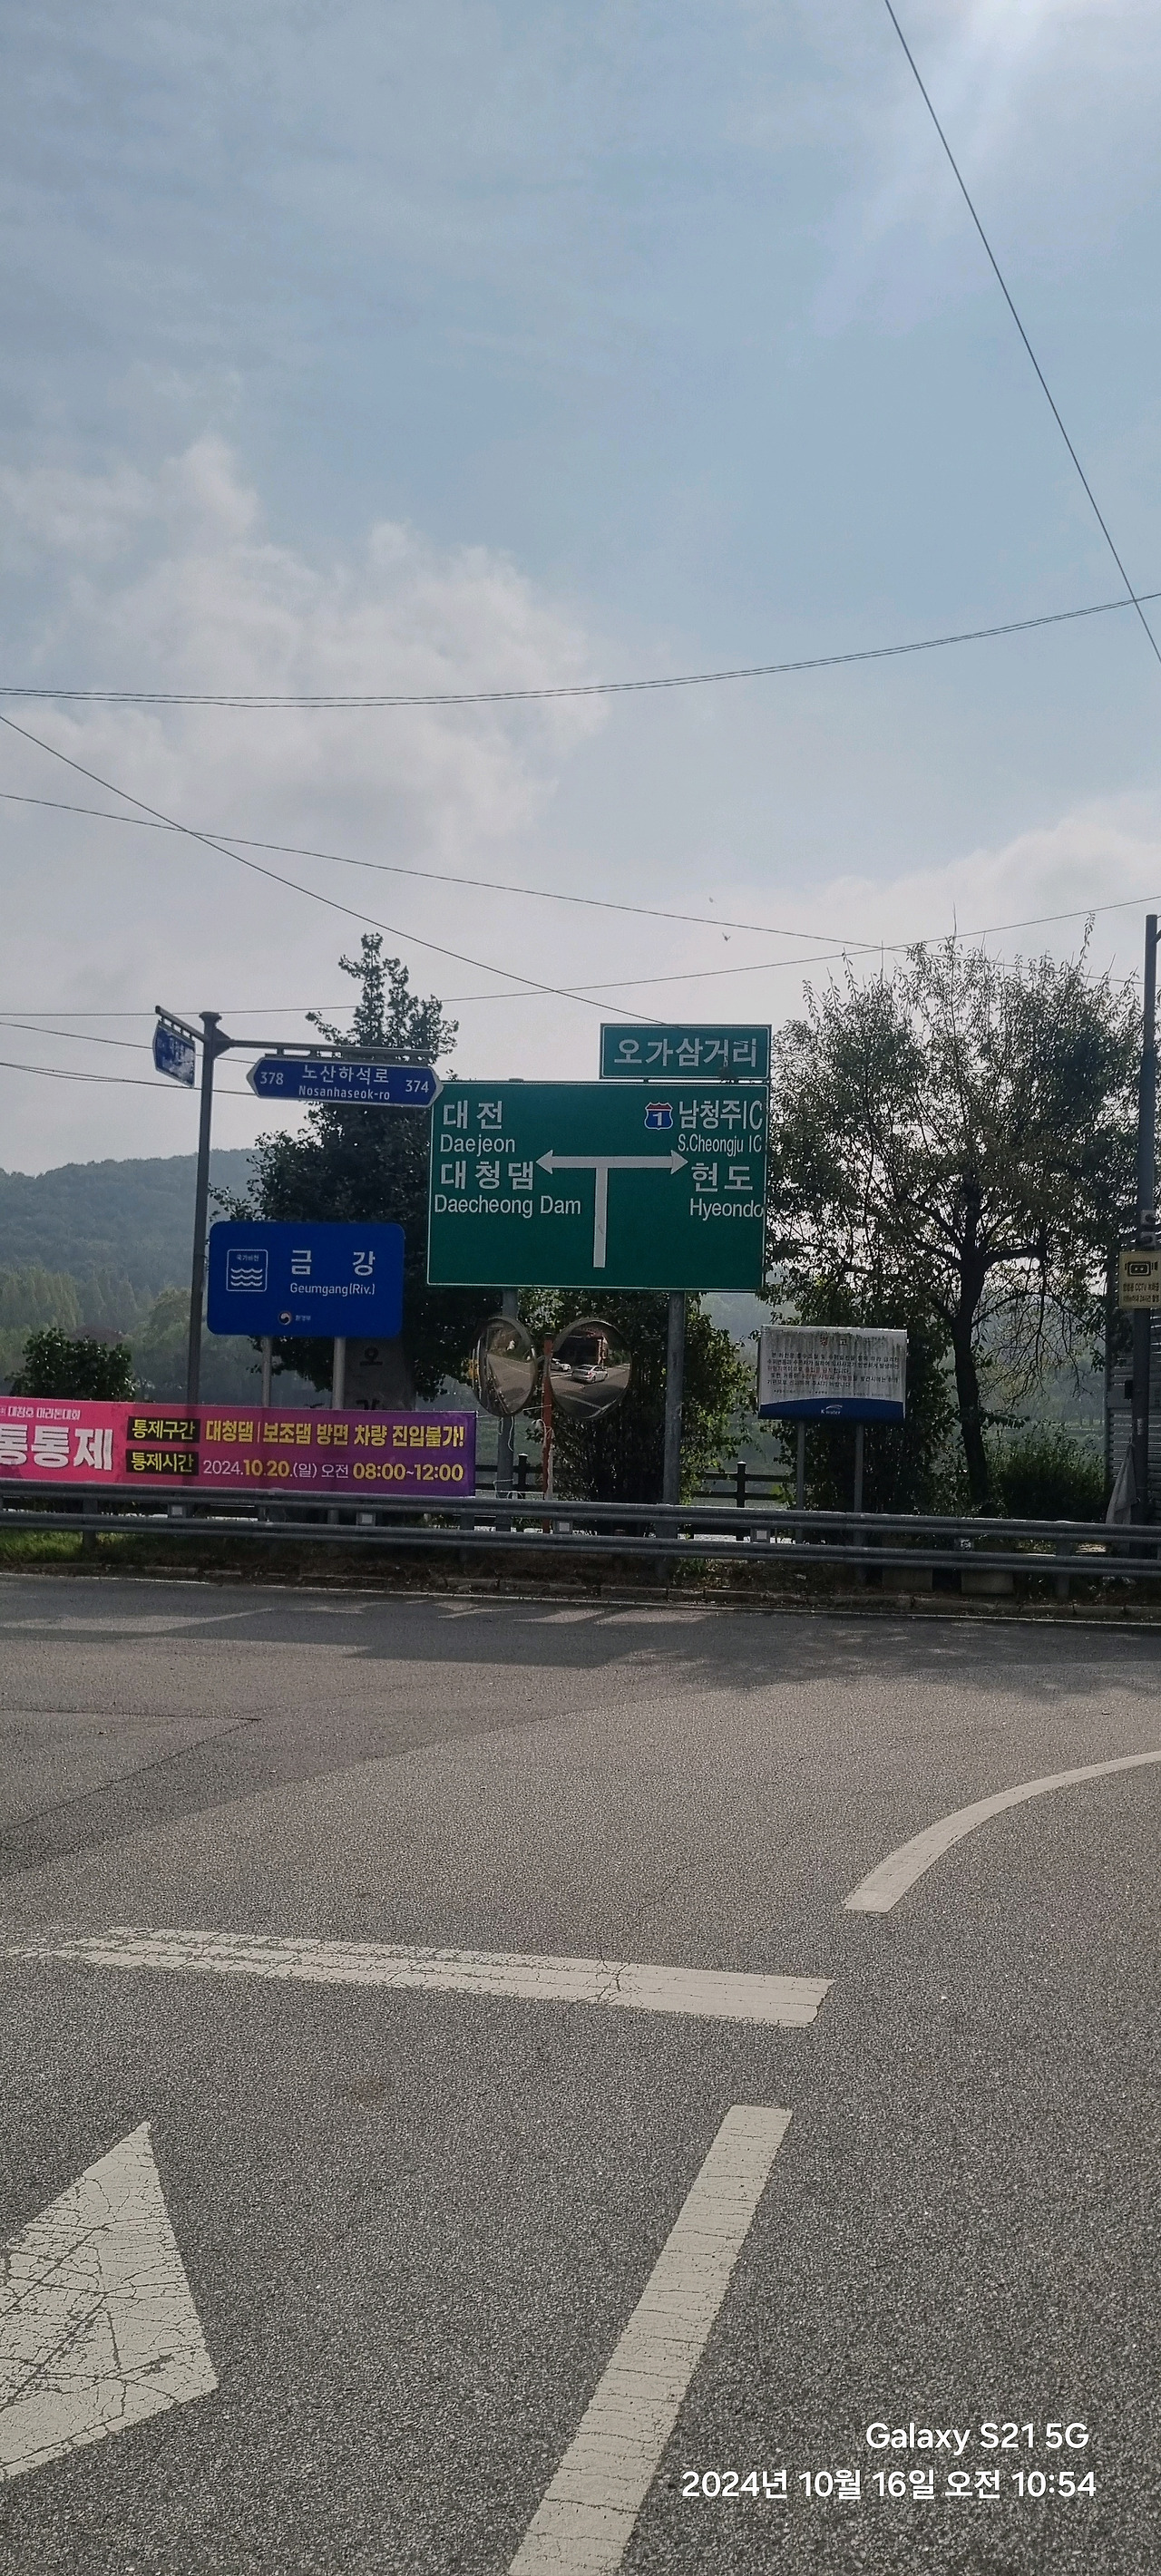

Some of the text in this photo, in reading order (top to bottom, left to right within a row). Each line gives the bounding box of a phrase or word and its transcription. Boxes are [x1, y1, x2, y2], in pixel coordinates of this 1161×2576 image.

[614, 1037, 756, 1067] 오가삼거리
[260, 1072, 284, 1085] 378
[302, 1064, 389, 1085] 노산하석로
[298, 1085, 390, 1101] Nosanhaseok-ro
[405, 1080, 429, 1094] 374
[443, 1100, 502, 1130] 대전
[652, 1112, 662, 1126] 1
[440, 1133, 515, 1157] Daejeon
[678, 1133, 762, 1157] S.Cheongju IC
[441, 1160, 533, 1191] 대청댐
[690, 1162, 753, 1192] 현도
[434, 1194, 580, 1219] Daecheong Dam
[689, 1198, 765, 1221] Hyeondo
[132, 1419, 464, 1448] 통제구간 대청댐 보조댐 방면 차량 진입불가!
[131, 1452, 463, 1482] 통제시간 2024.10.20.(일) 오전 08:00~12:00
